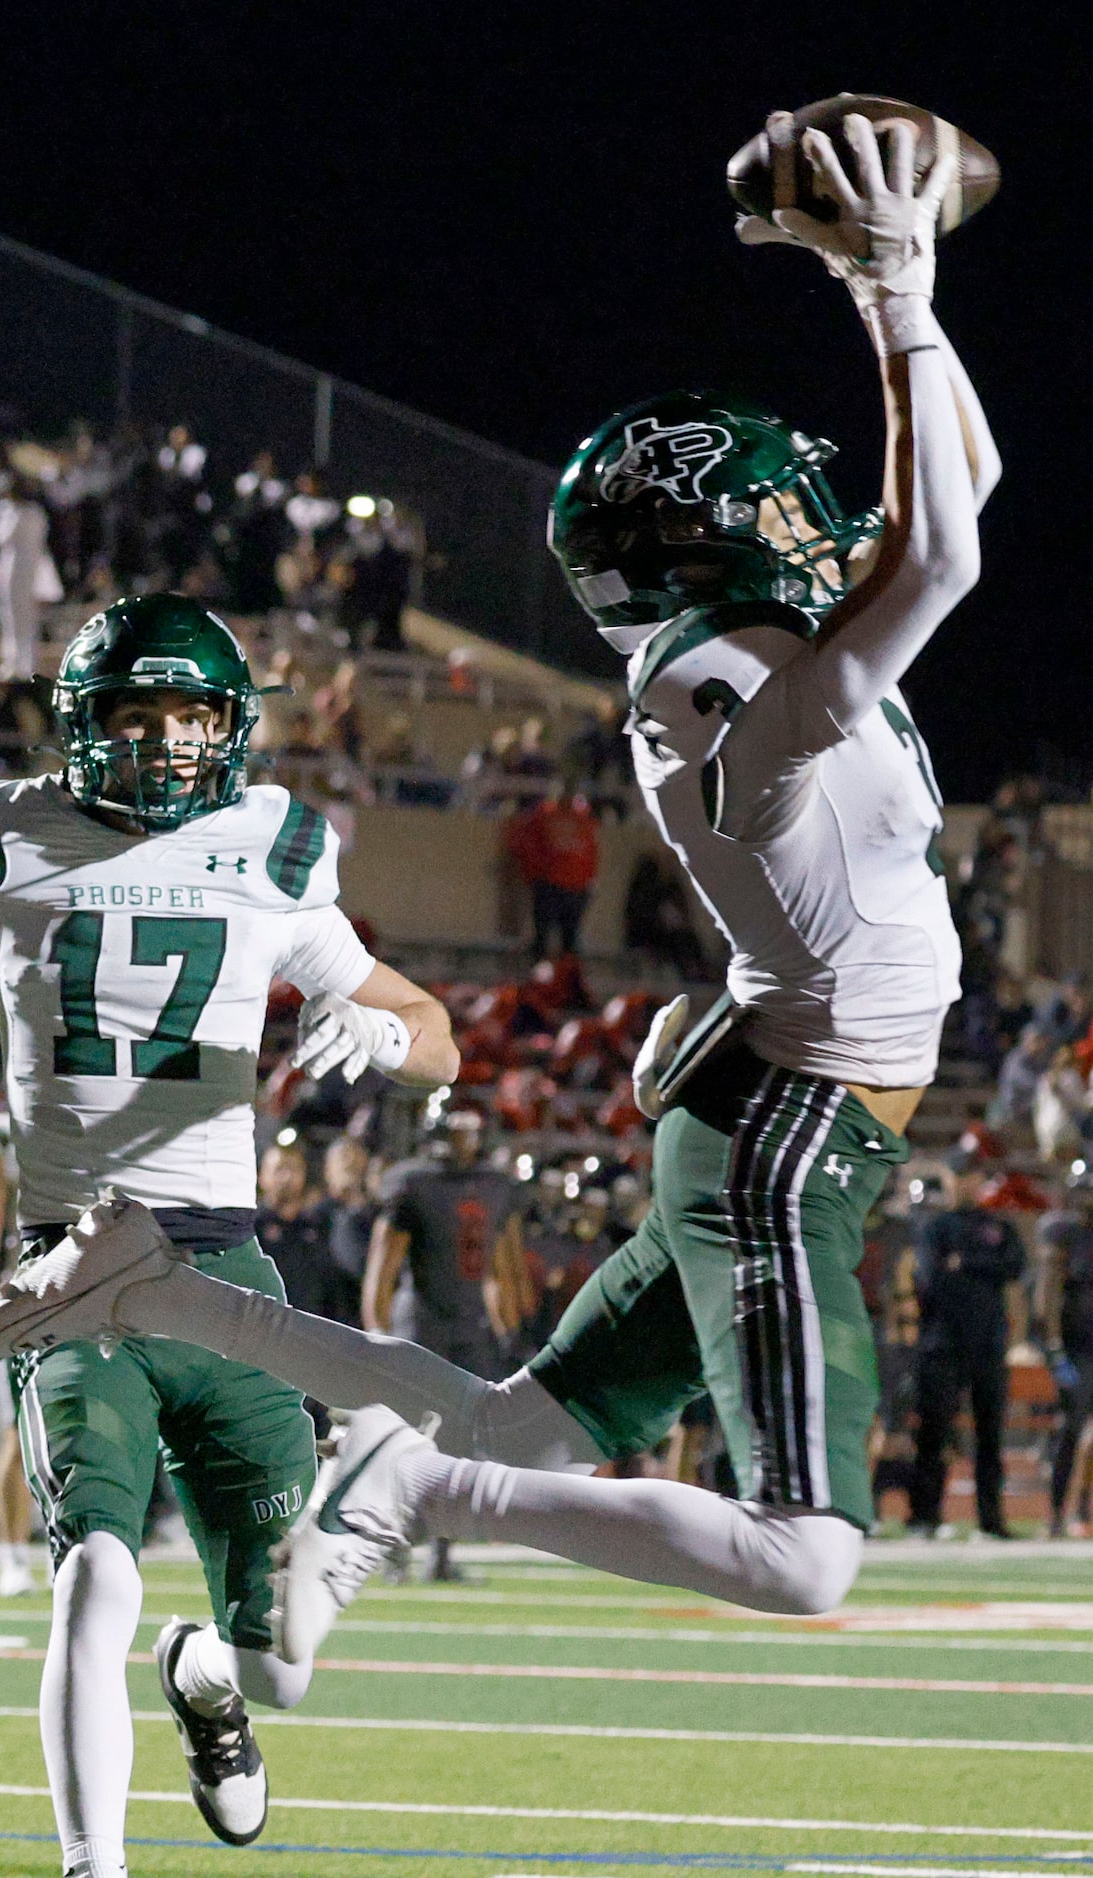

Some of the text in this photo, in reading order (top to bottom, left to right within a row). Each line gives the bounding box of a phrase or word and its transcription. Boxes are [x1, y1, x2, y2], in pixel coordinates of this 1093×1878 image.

[67, 885, 205, 908] PROSPER
[47, 910, 228, 1080] 17
[251, 1484, 303, 1525] DYJ
